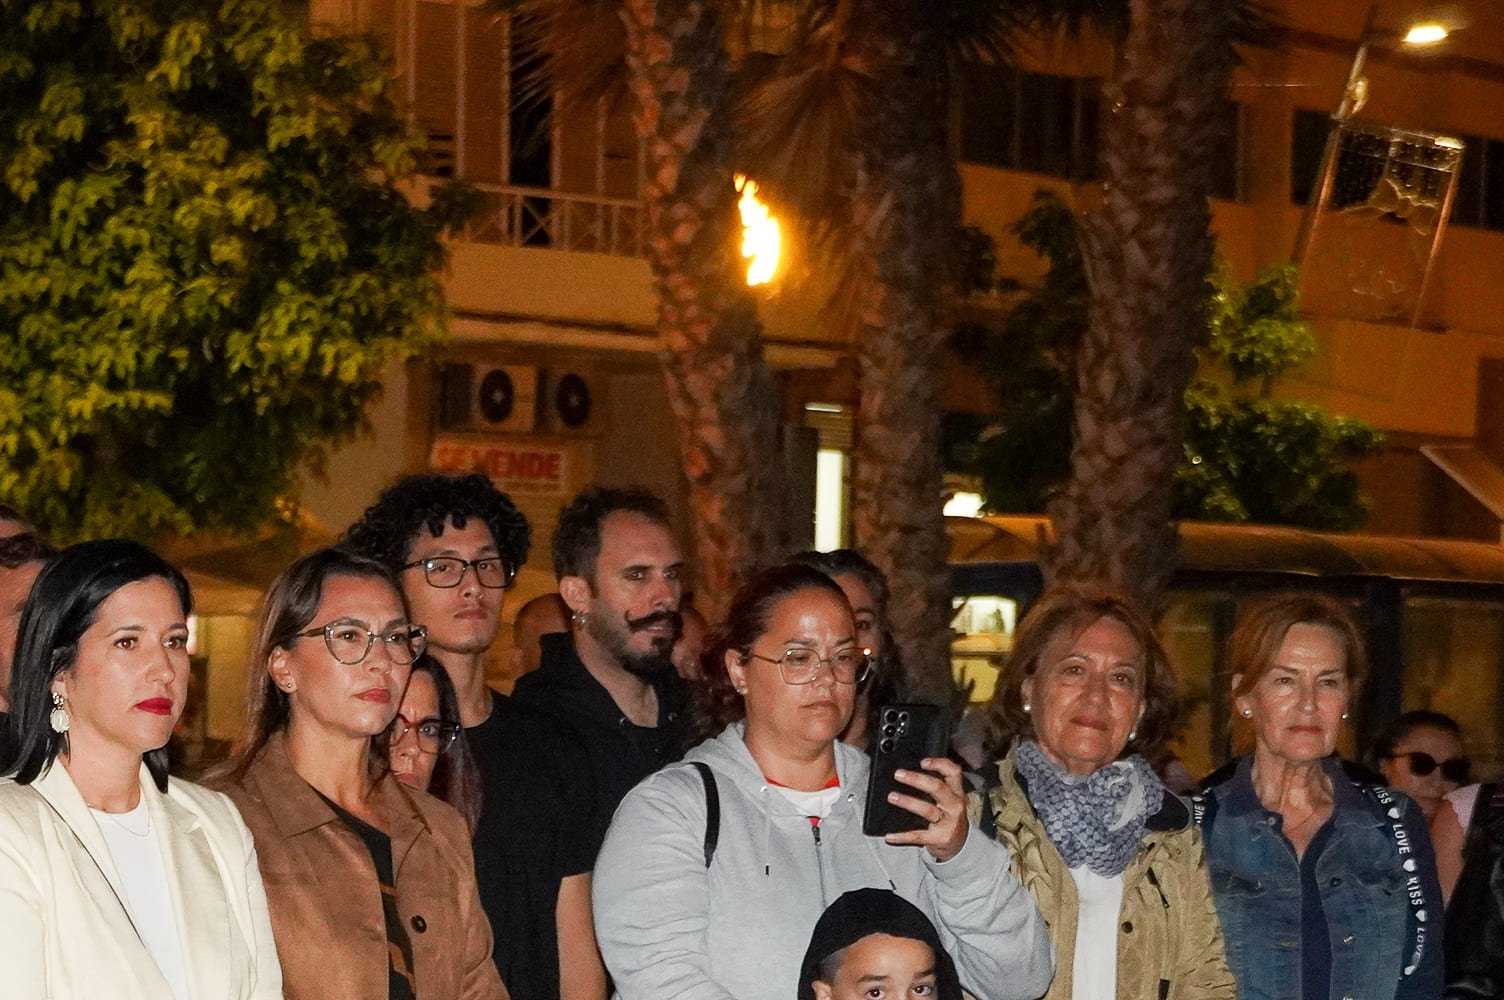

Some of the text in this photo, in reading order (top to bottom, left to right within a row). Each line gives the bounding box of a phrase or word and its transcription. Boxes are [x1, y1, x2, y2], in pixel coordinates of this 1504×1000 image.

[437, 446, 465, 471] SE
[1392, 823, 1410, 855] LOVE
[1406, 876, 1423, 906] KISS
[1412, 926, 1425, 965] LOVE
